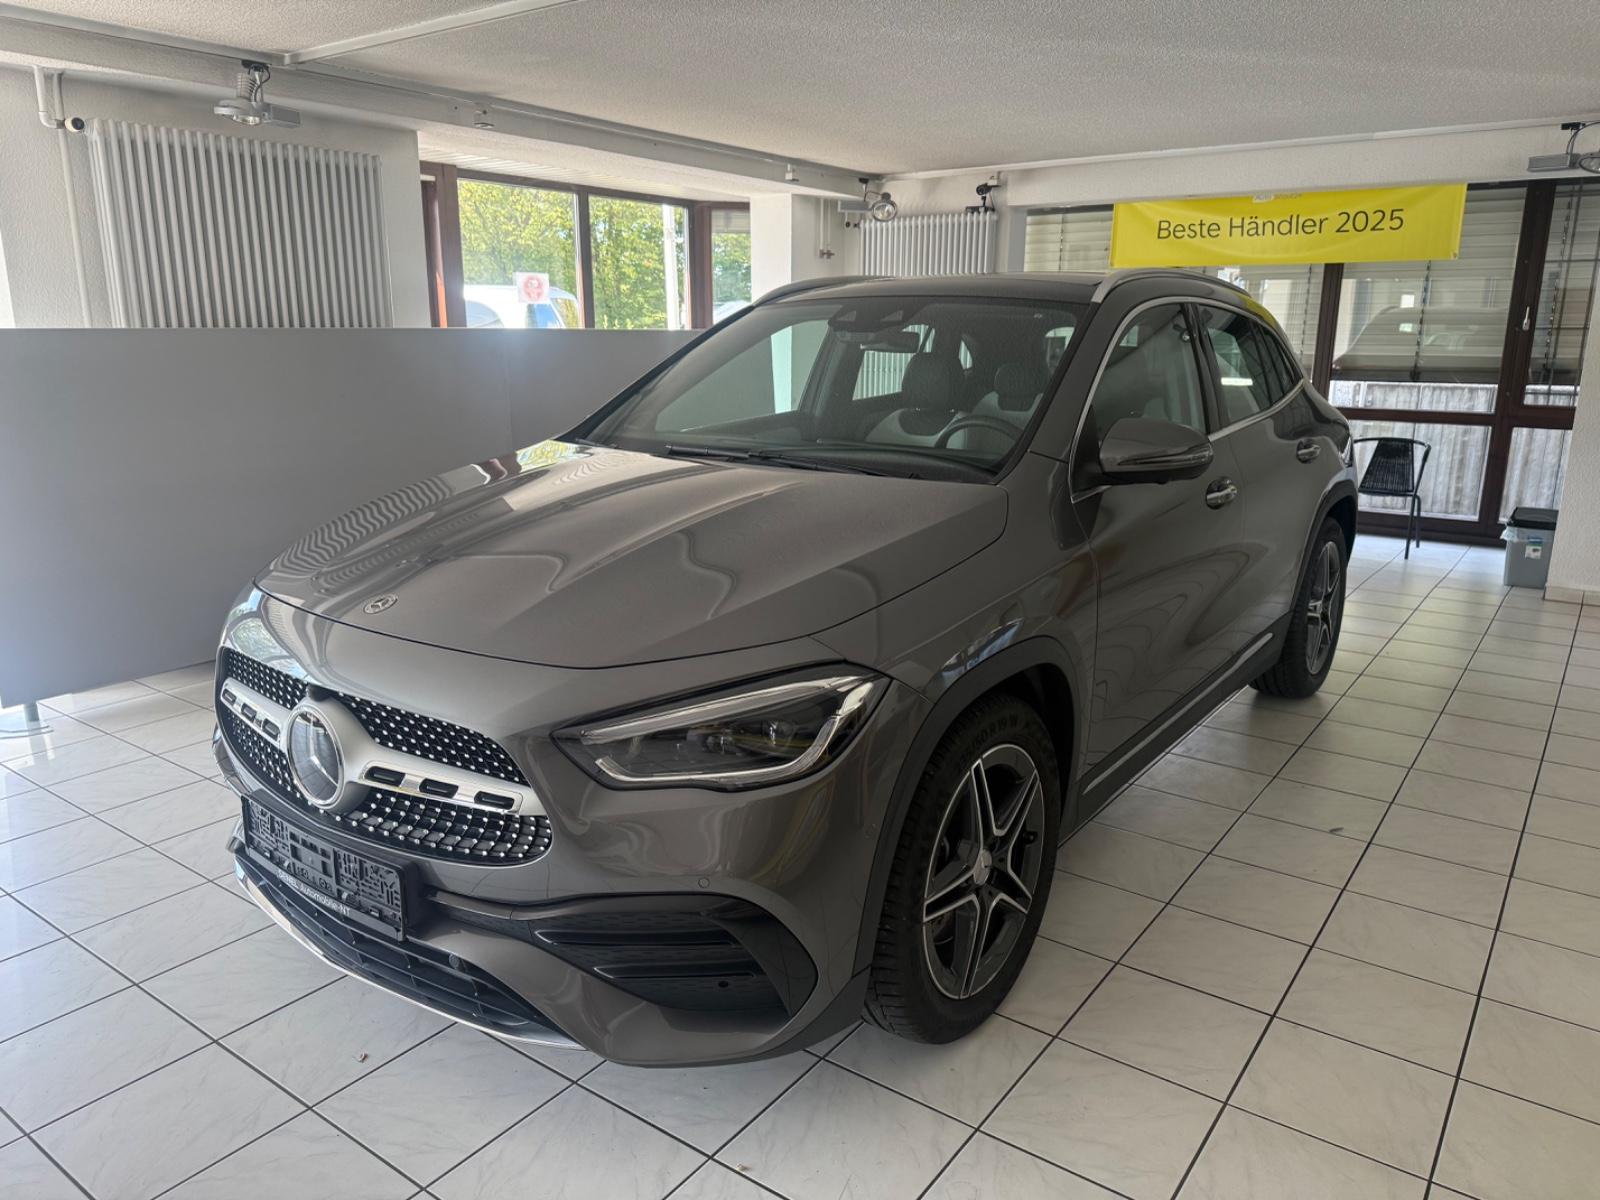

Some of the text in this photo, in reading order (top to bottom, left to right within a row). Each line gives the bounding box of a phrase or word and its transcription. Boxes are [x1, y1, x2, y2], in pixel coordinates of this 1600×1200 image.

[1157, 208, 1404, 239] Beste Händler 2025
